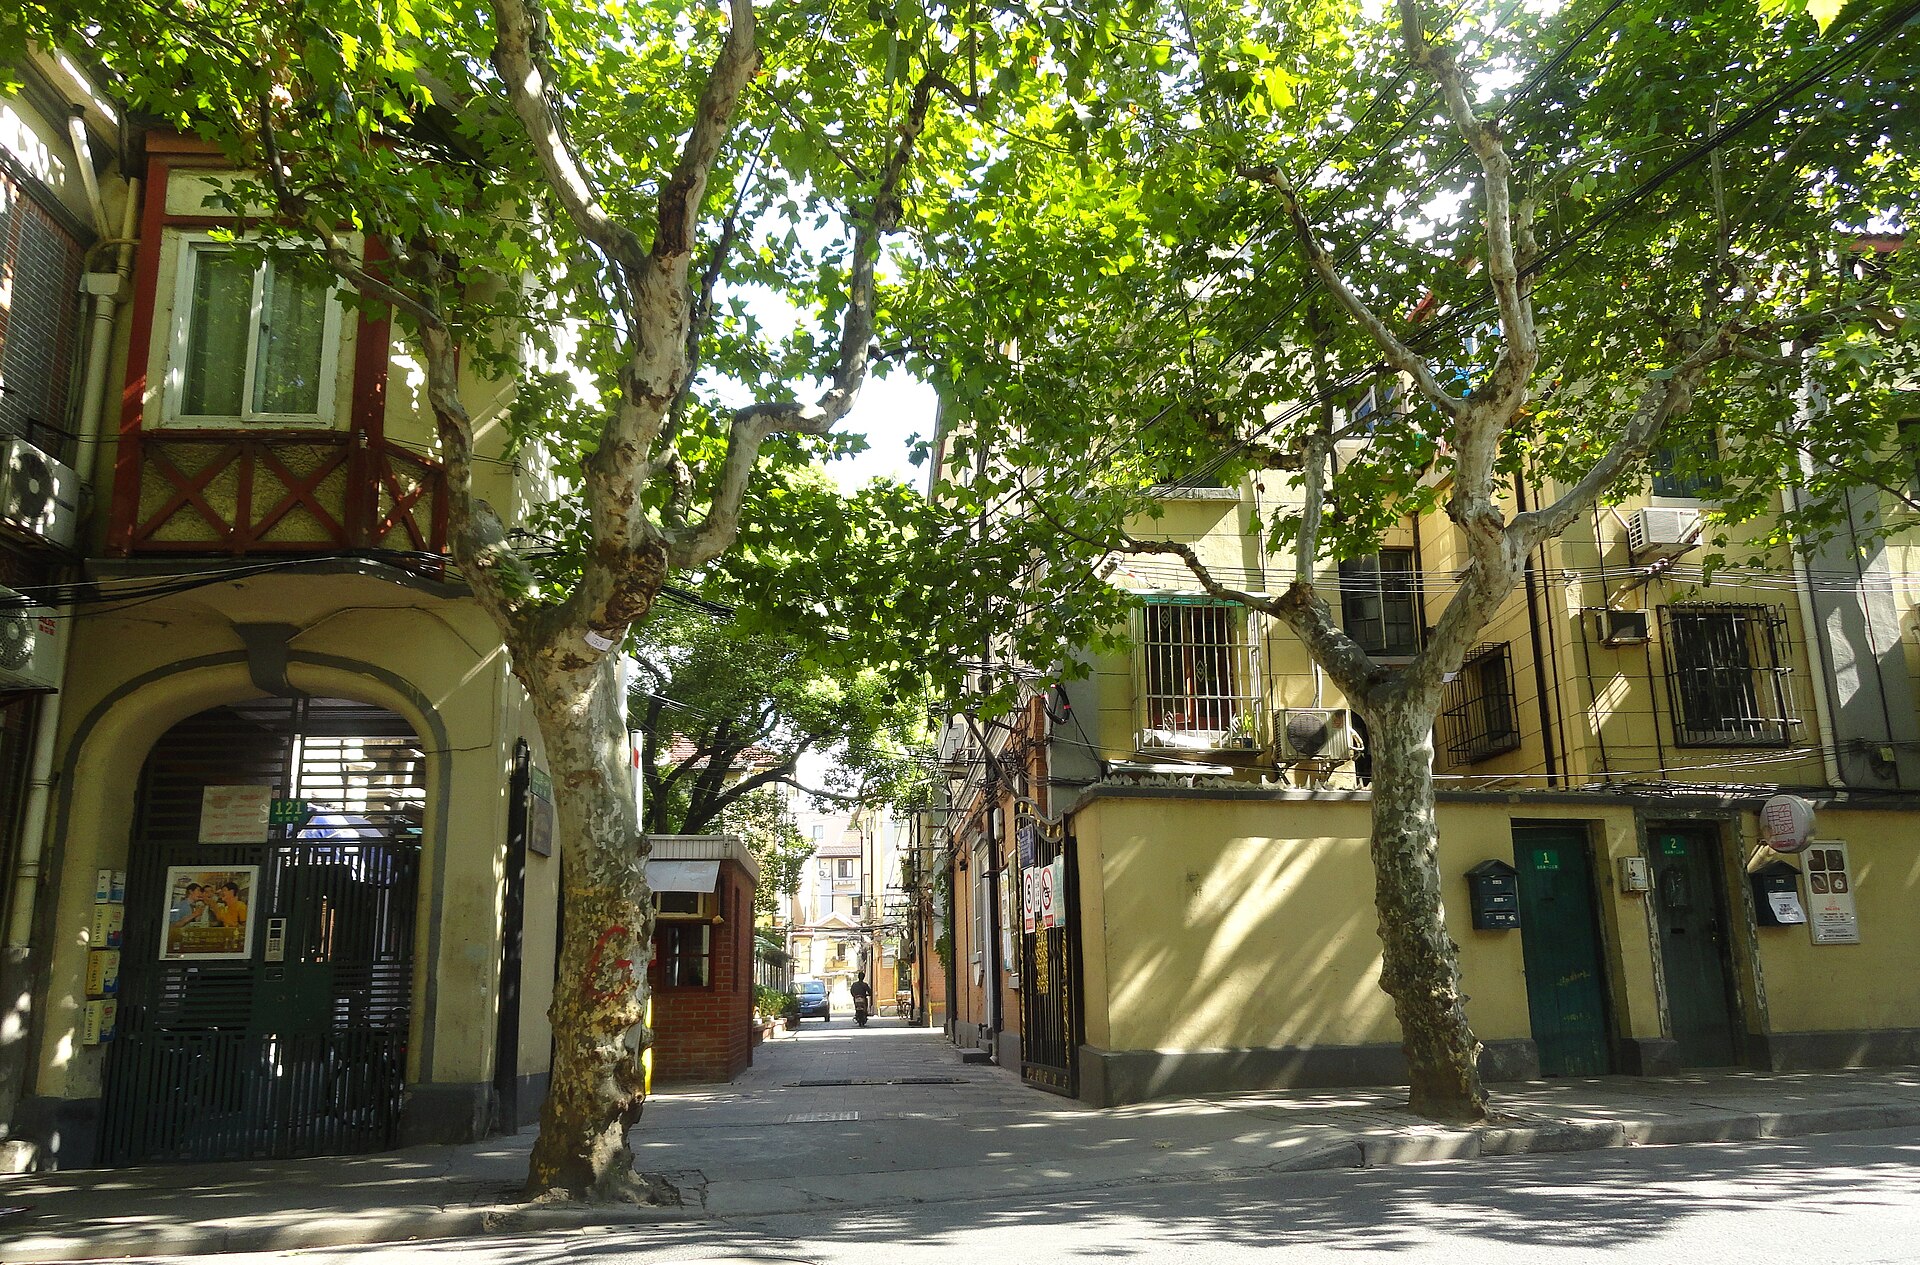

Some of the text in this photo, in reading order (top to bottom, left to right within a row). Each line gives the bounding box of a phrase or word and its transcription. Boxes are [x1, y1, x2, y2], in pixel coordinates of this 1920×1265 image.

[275, 801, 303, 815] 121
[1670, 837, 1677, 849] 2
[1543, 852, 1550, 864] 1
